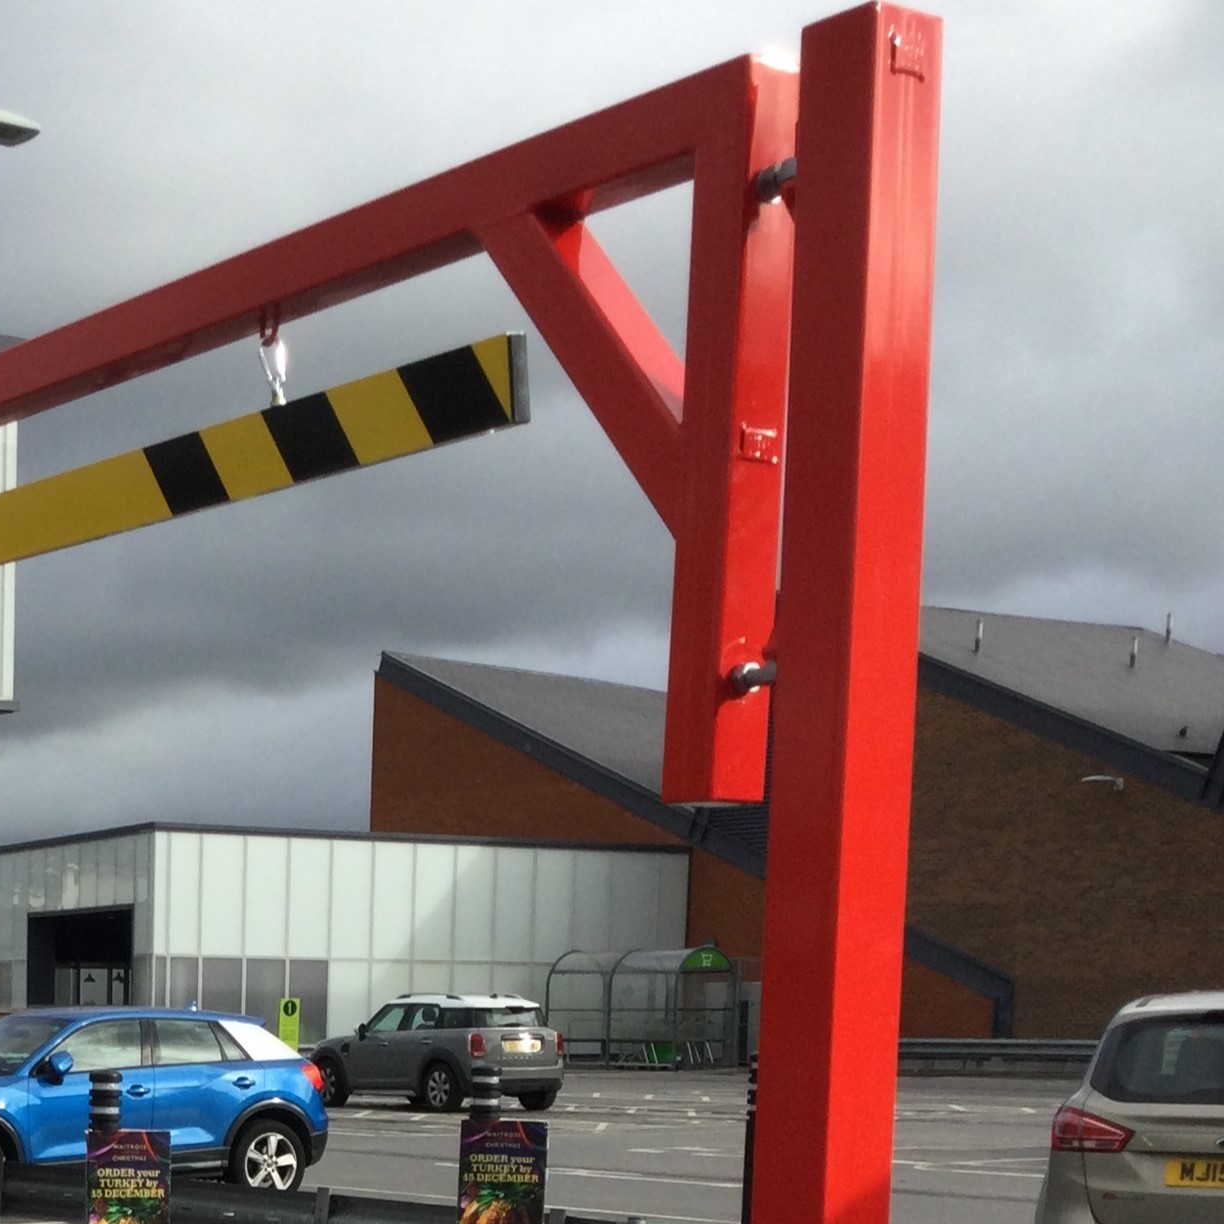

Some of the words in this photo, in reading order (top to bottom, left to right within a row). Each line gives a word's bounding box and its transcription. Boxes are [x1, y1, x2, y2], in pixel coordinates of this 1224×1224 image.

[469, 1153, 508, 1163] ORDER
[510, 1156, 536, 1165] your
[97, 1168, 135, 1177] ORDER
[136, 1170, 161, 1179] your
[471, 1163, 518, 1173] TURKEY
[519, 1164, 532, 1175] by
[99, 1178, 145, 1188] TURKEY
[146, 1178, 159, 1189] by
[476, 1173, 539, 1183] DECEMBER
[91, 1189, 103, 1198] 15
[104, 1189, 165, 1198] DECEMBER
